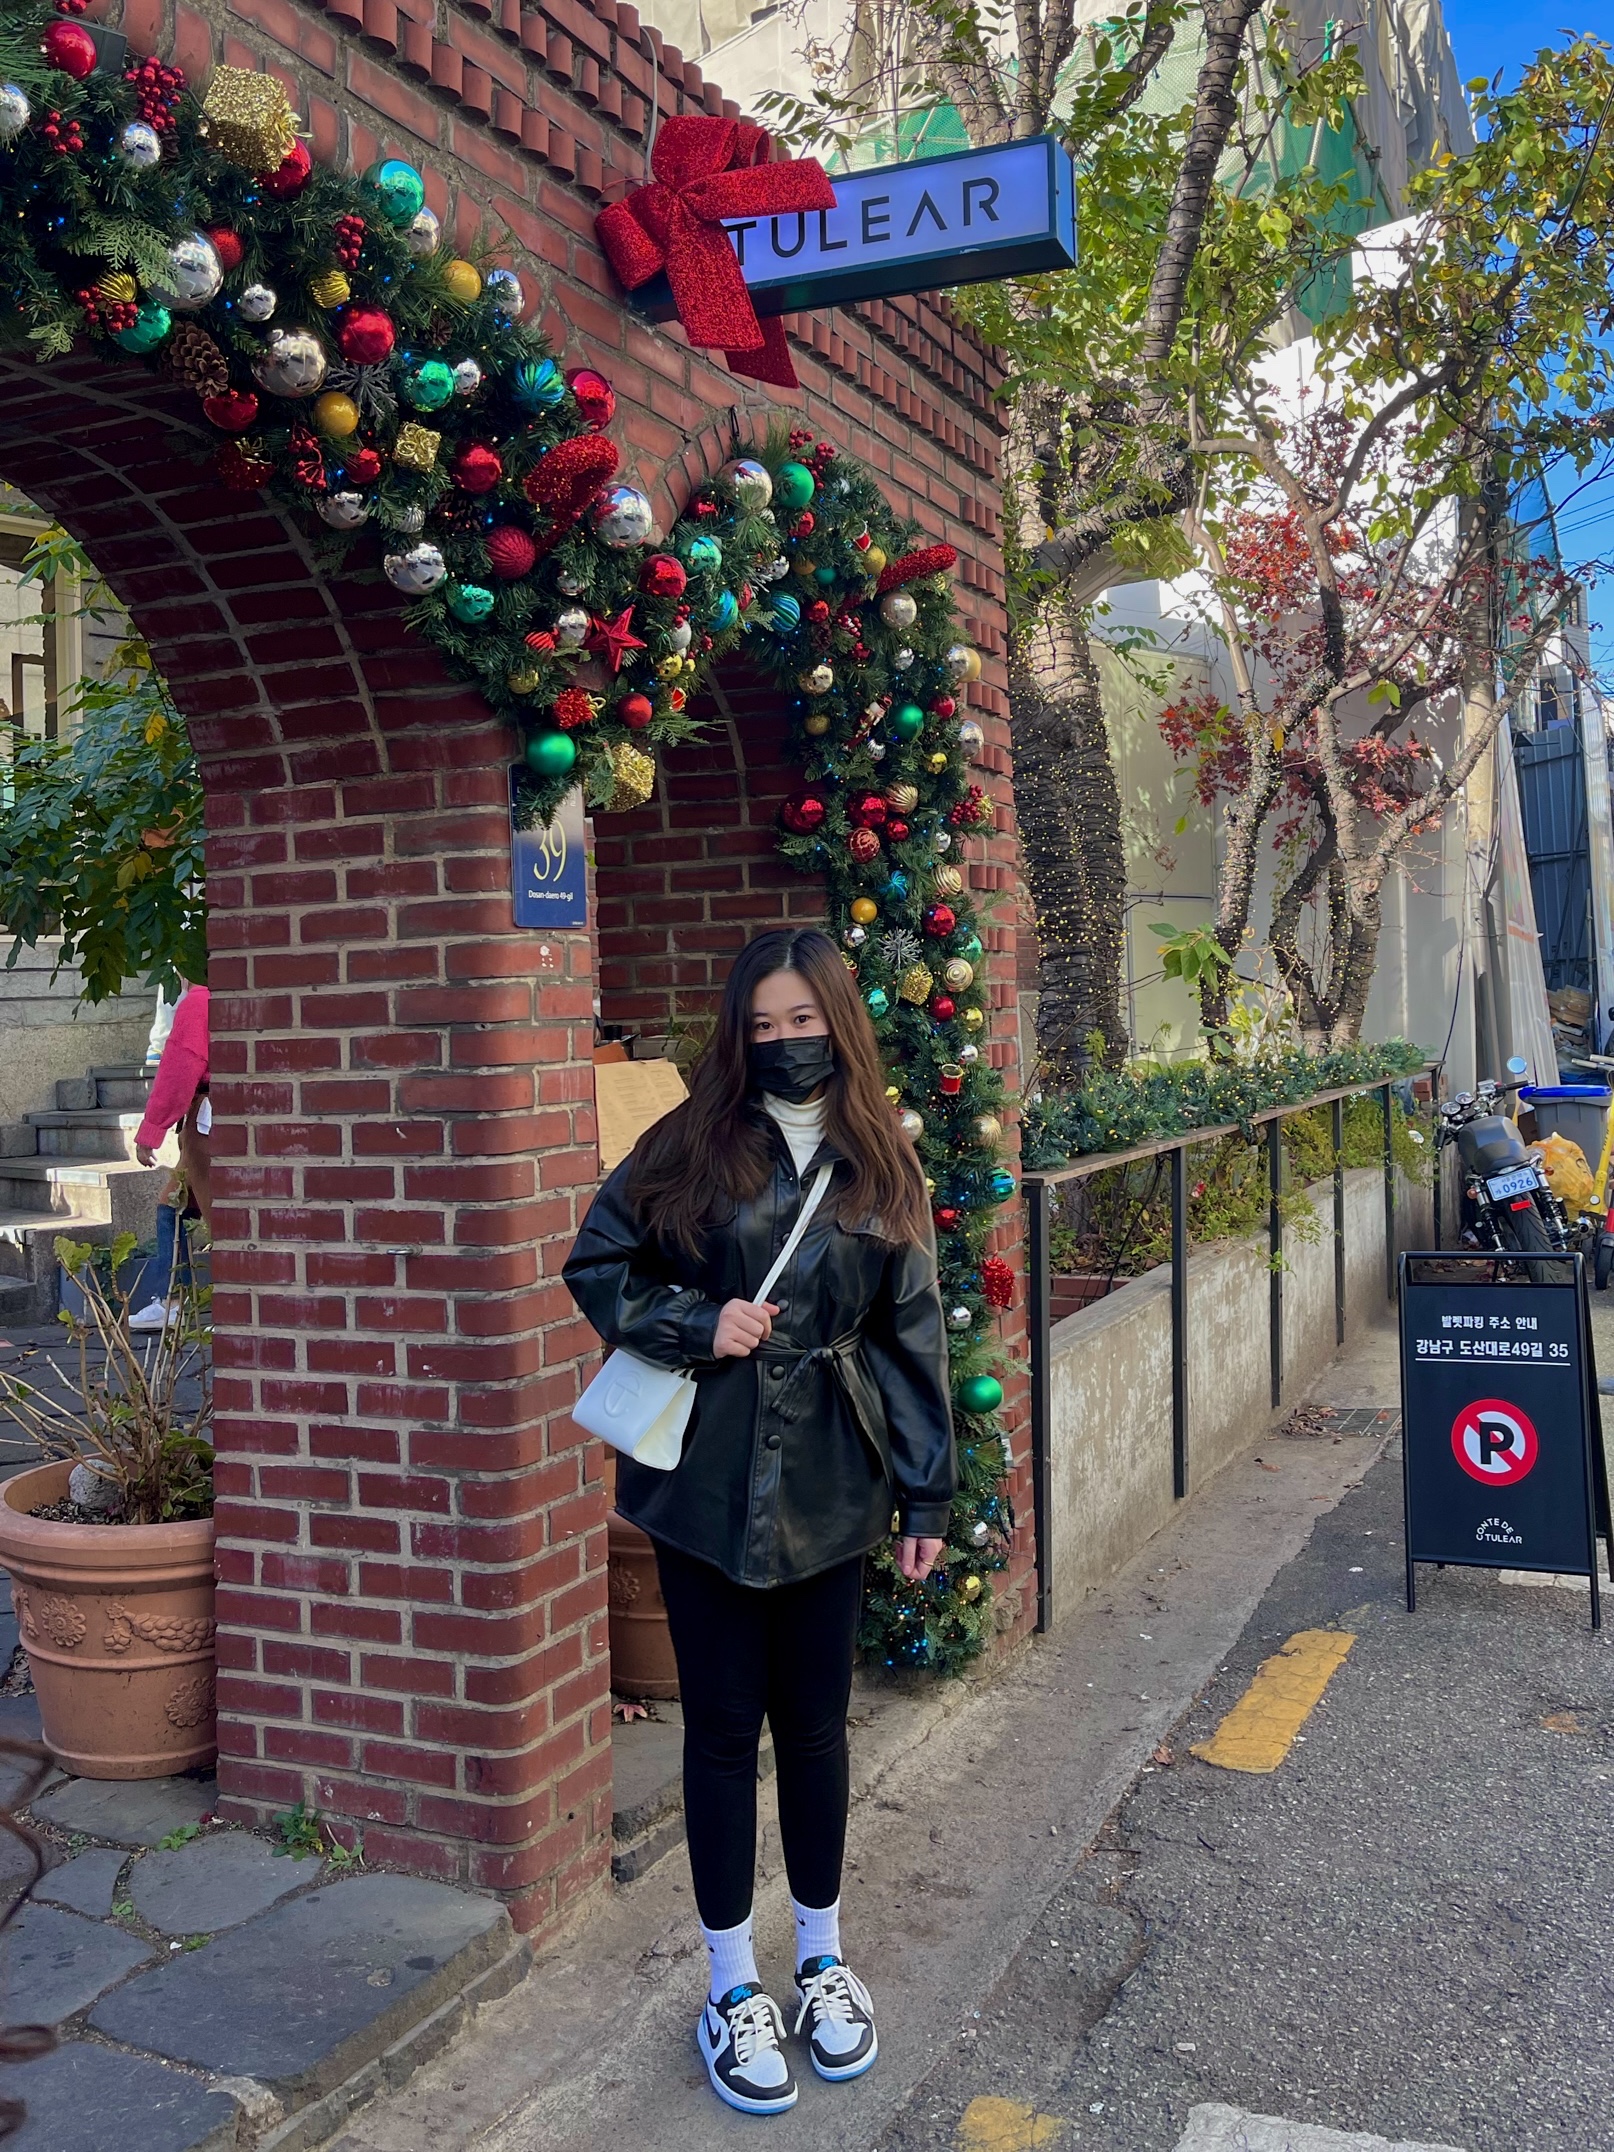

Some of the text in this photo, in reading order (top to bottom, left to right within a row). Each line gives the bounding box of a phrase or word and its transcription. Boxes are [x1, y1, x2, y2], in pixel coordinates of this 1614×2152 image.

[528, 889, 560, 900] Dosan-daero
[1502, 1177, 1533, 1193] 0926
[1441, 1315, 1538, 1330] 발렛파킹 주소 안내
[1416, 1339, 1569, 1358] 강남구 도산대로49길 35
[1479, 1421, 1515, 1466] P
[1475, 1517, 1514, 1541] CONTE DE
[1484, 1533, 1523, 1544] TULEAR
